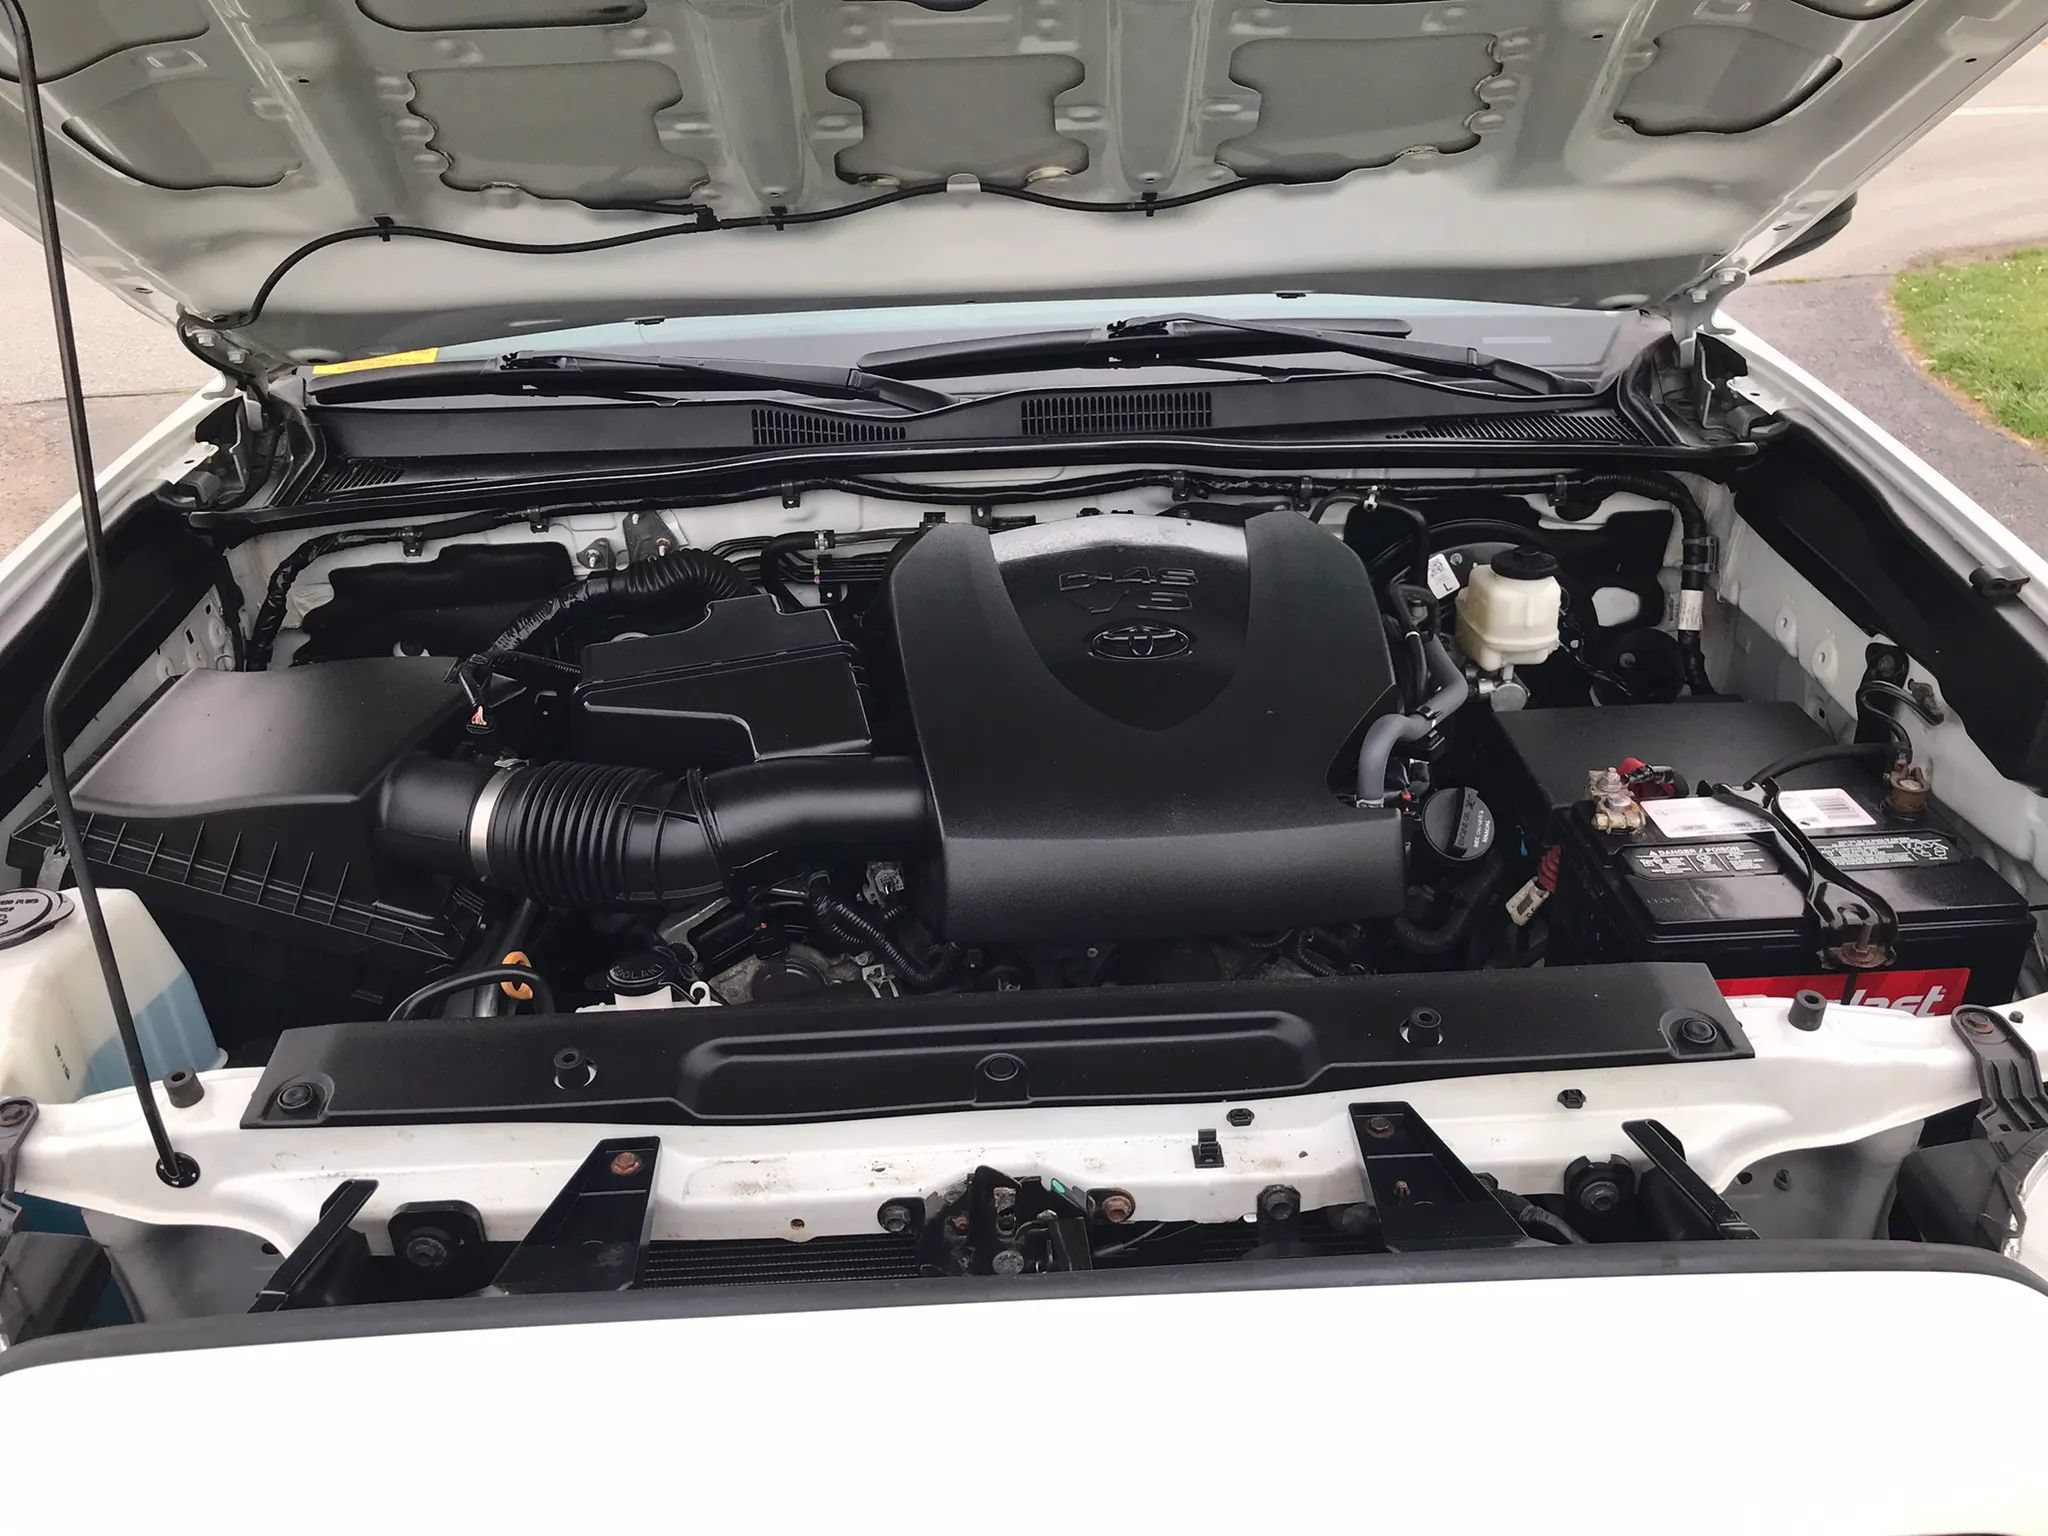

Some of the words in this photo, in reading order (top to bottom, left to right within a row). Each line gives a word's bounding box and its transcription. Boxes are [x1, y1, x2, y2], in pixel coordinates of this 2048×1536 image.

[1058, 566, 1199, 591] D-4S
[1657, 848, 1697, 856] DANGER
[1704, 846, 1741, 854] POISON
[615, 963, 663, 979] COOLANT
